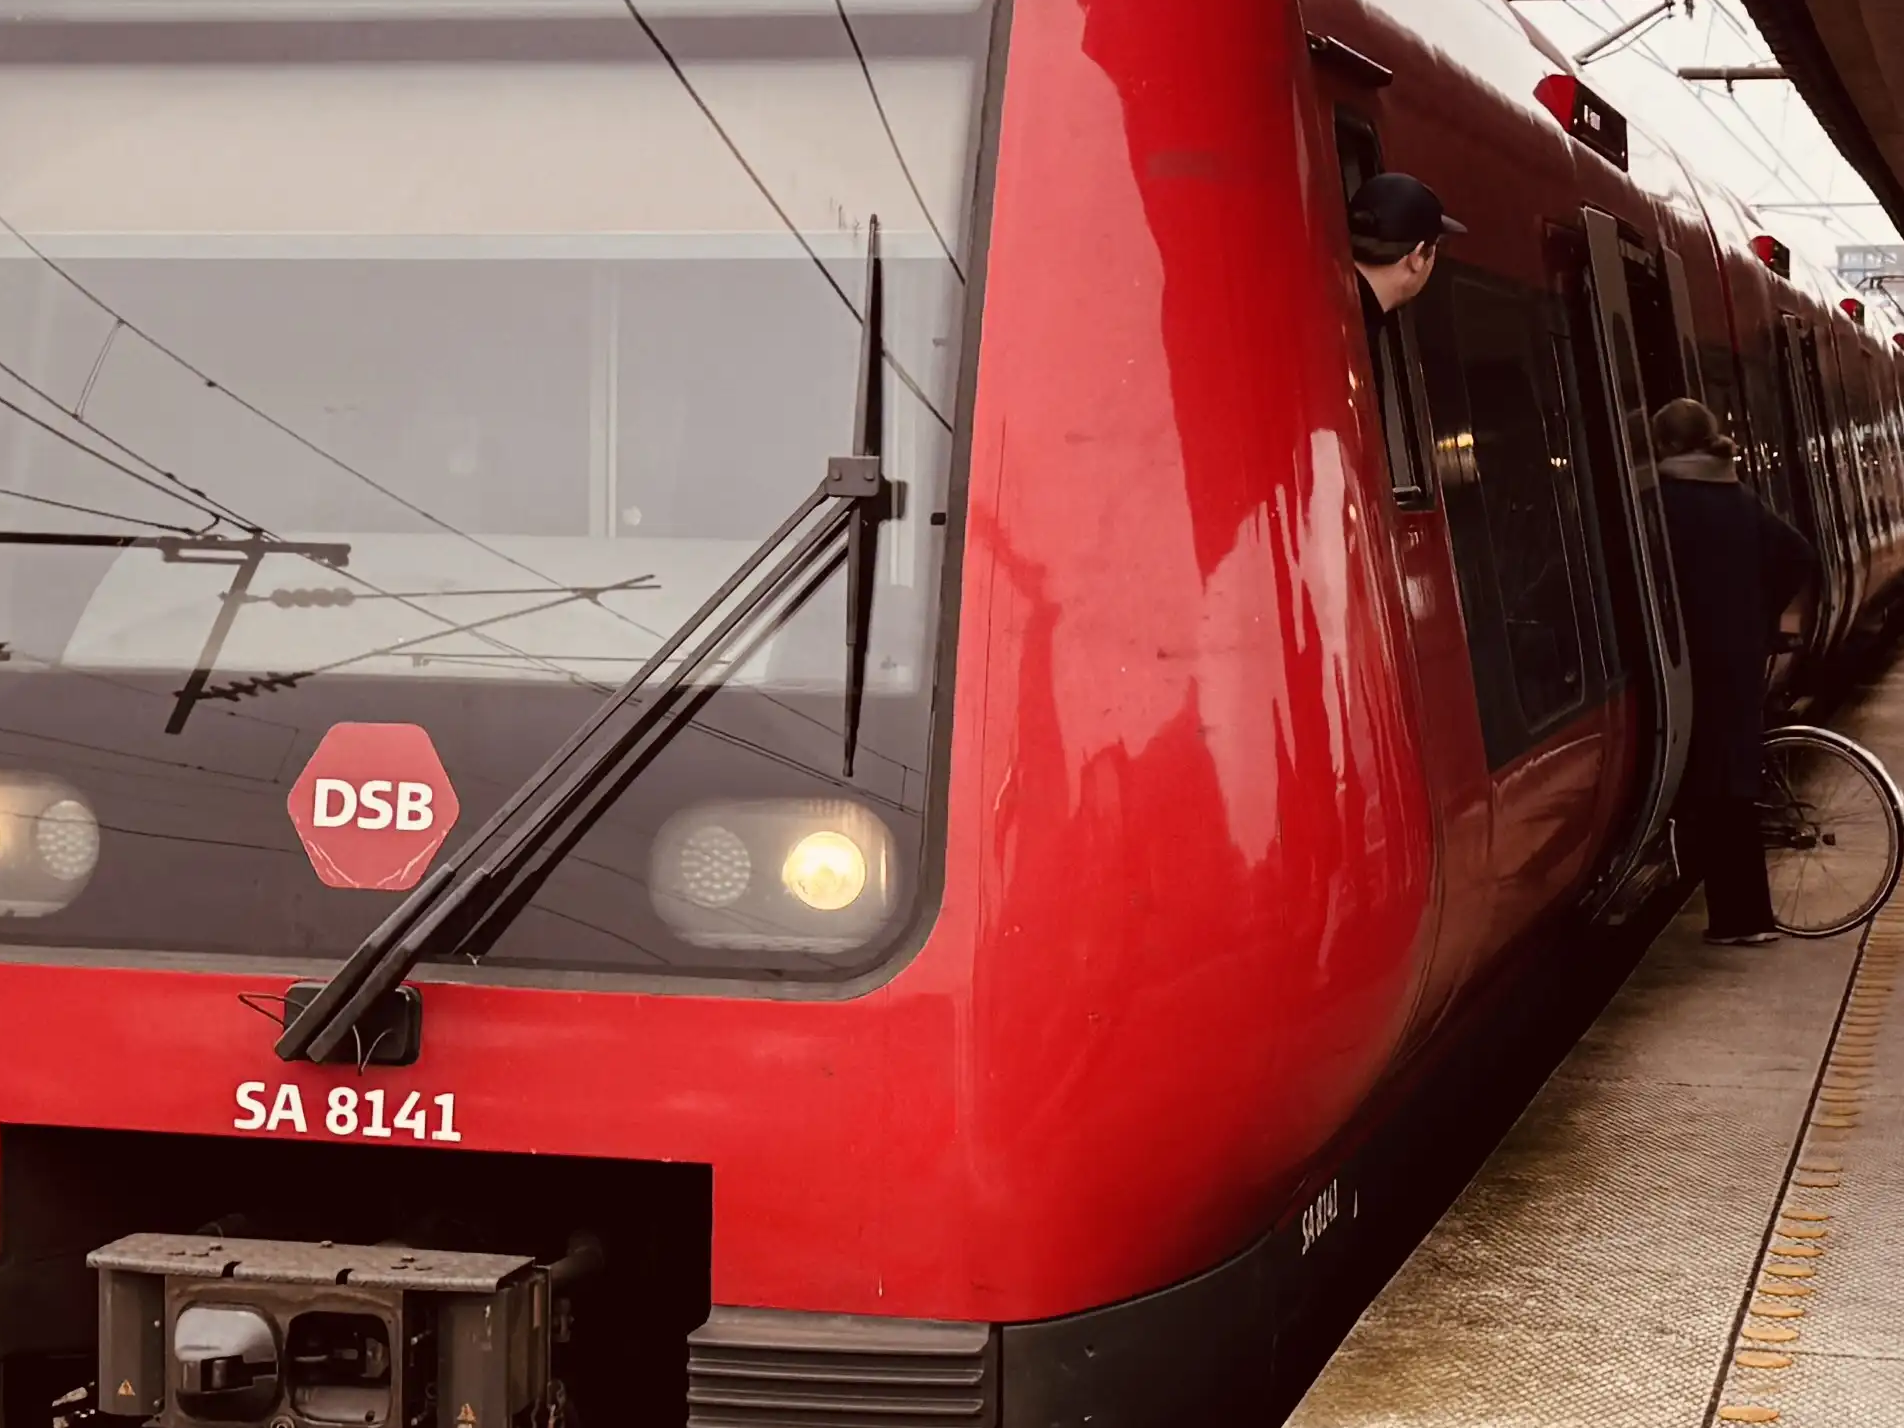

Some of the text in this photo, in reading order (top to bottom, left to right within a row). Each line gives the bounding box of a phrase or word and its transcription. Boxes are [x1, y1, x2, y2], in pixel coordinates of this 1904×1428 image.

[313, 778, 434, 831] DSB
[233, 1081, 462, 1142] SA 8141
